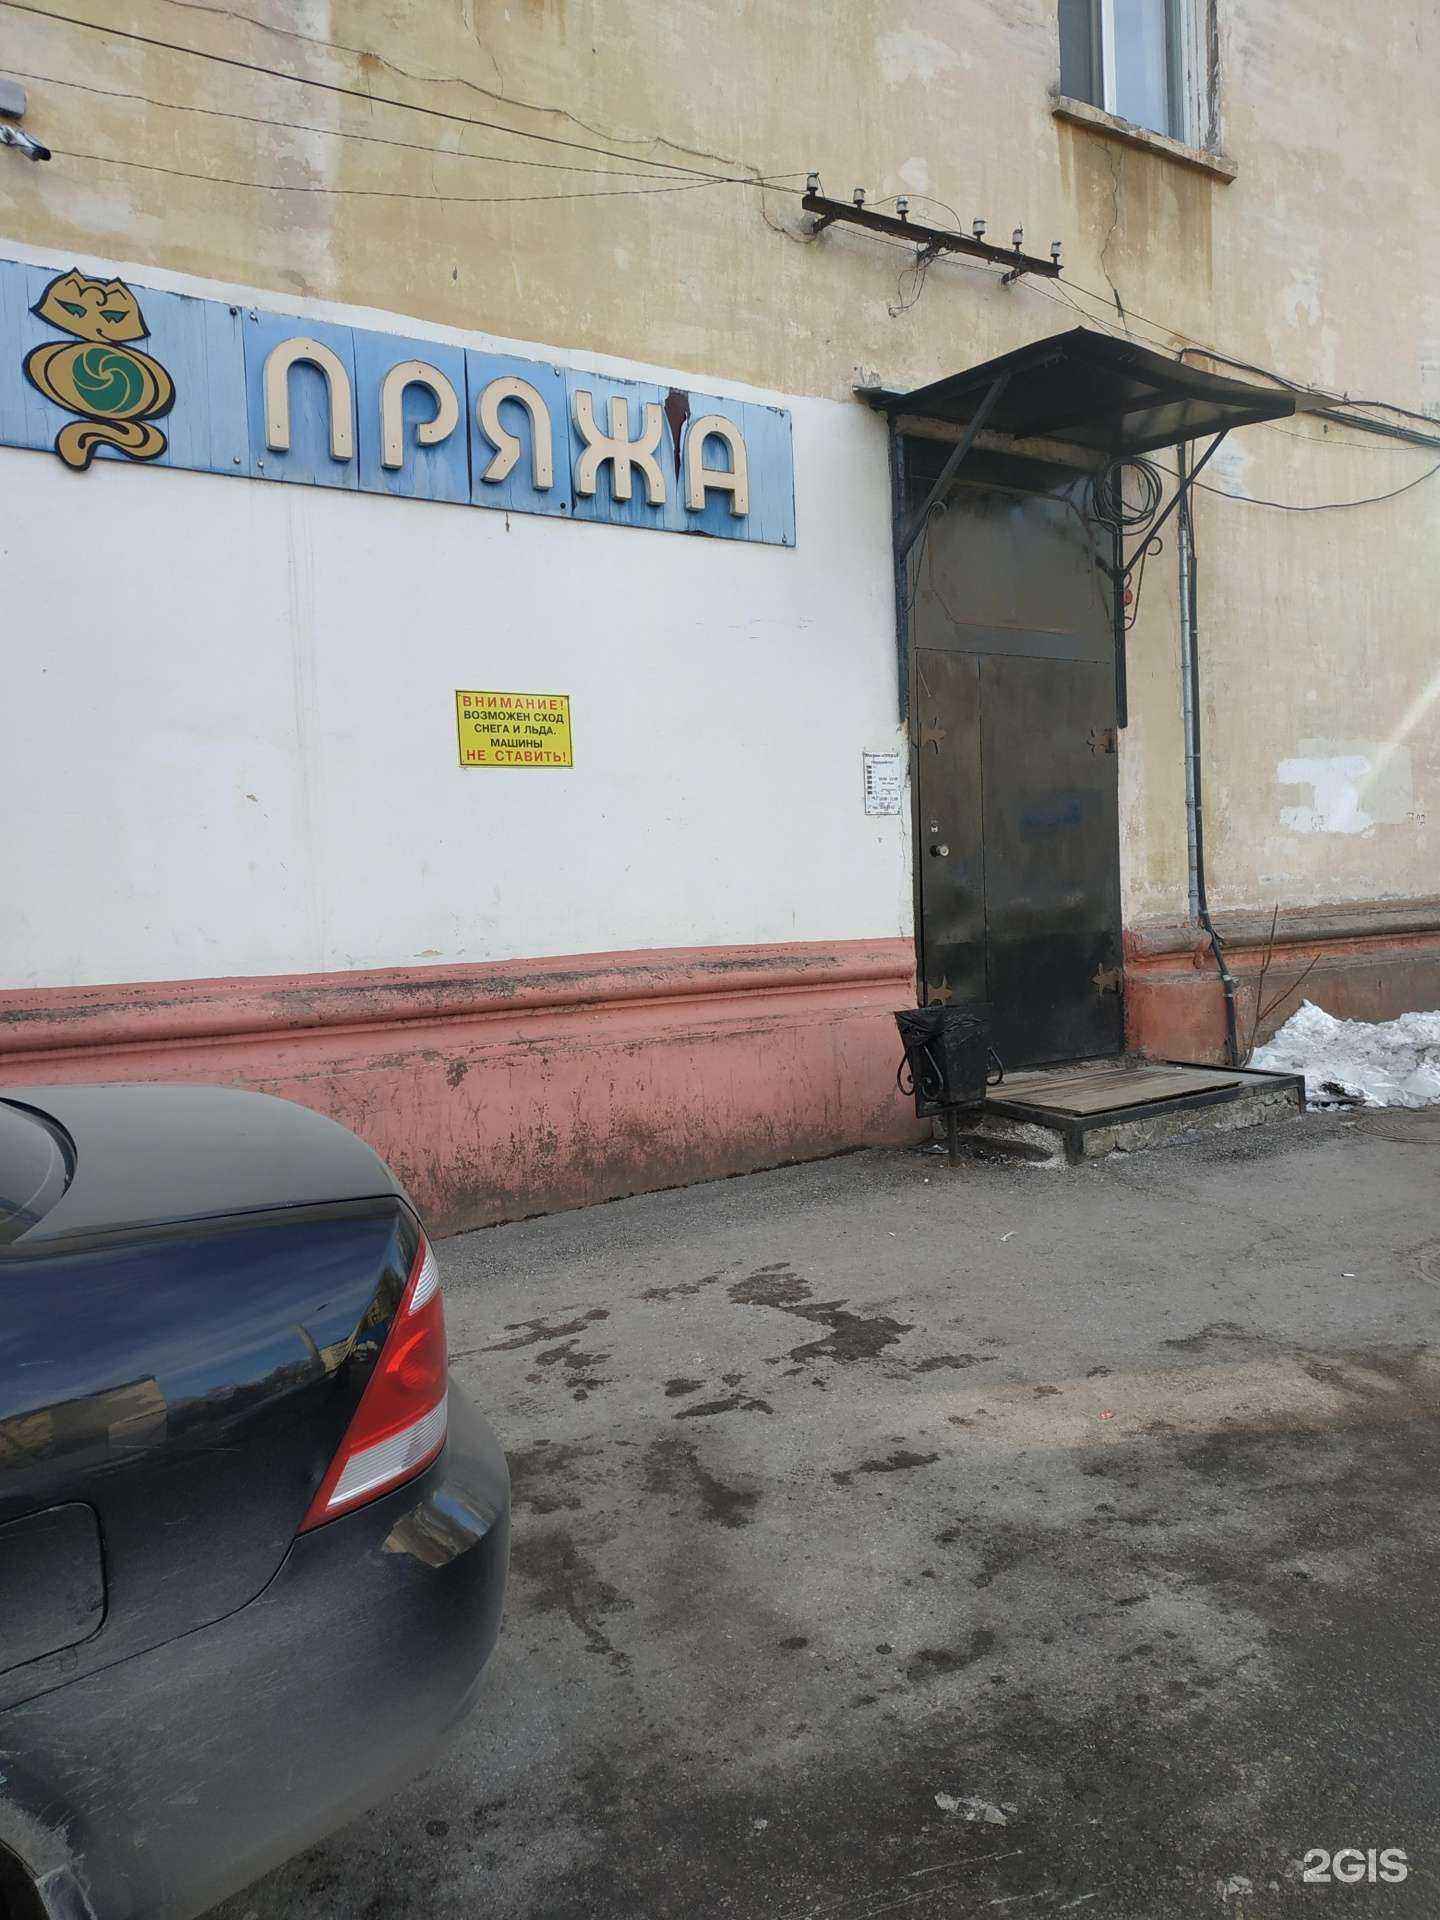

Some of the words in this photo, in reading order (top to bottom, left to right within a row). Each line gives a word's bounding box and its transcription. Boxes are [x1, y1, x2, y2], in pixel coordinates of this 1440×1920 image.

[263, 336, 749, 518] ПРЯЖА
[463, 695, 564, 710] ВНИМАНИЕ!
[464, 710, 531, 722] ВОЗМОЖЕН
[534, 713, 564, 725] СХОД
[474, 723, 510, 734] СНЕГА
[513, 725, 521, 734] И
[490, 738, 543, 749] МАШИНЫ
[467, 749, 486, 761] НЕ
[495, 750, 567, 762] СТАВИТЬ!
